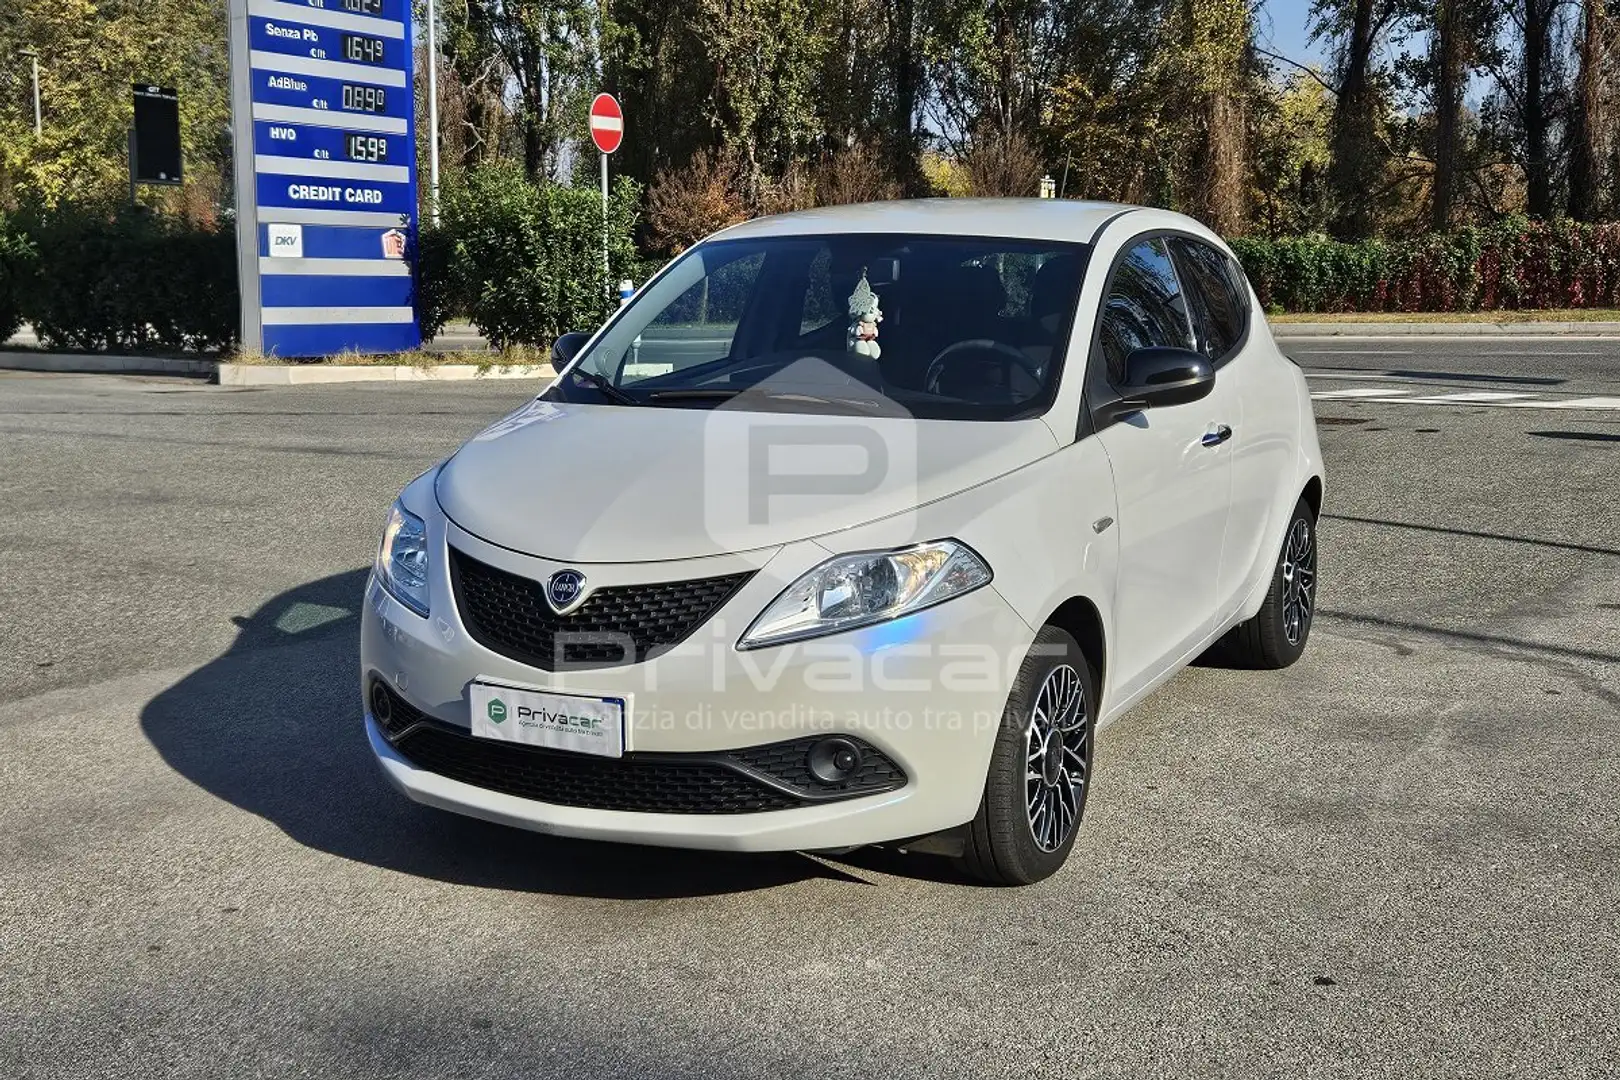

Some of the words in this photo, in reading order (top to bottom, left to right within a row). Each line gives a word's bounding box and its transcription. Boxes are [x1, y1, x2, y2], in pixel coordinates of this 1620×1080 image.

[265, 23, 300, 40] Senza
[303, 28, 319, 42] Pb
[268, 75, 308, 92] AdBlue
[269, 127, 297, 141] HVO
[288, 184, 342, 201] CREDIT
[345, 187, 383, 204] CARD
[275, 236, 297, 246] DKV
[518, 706, 602, 729] Privacar
